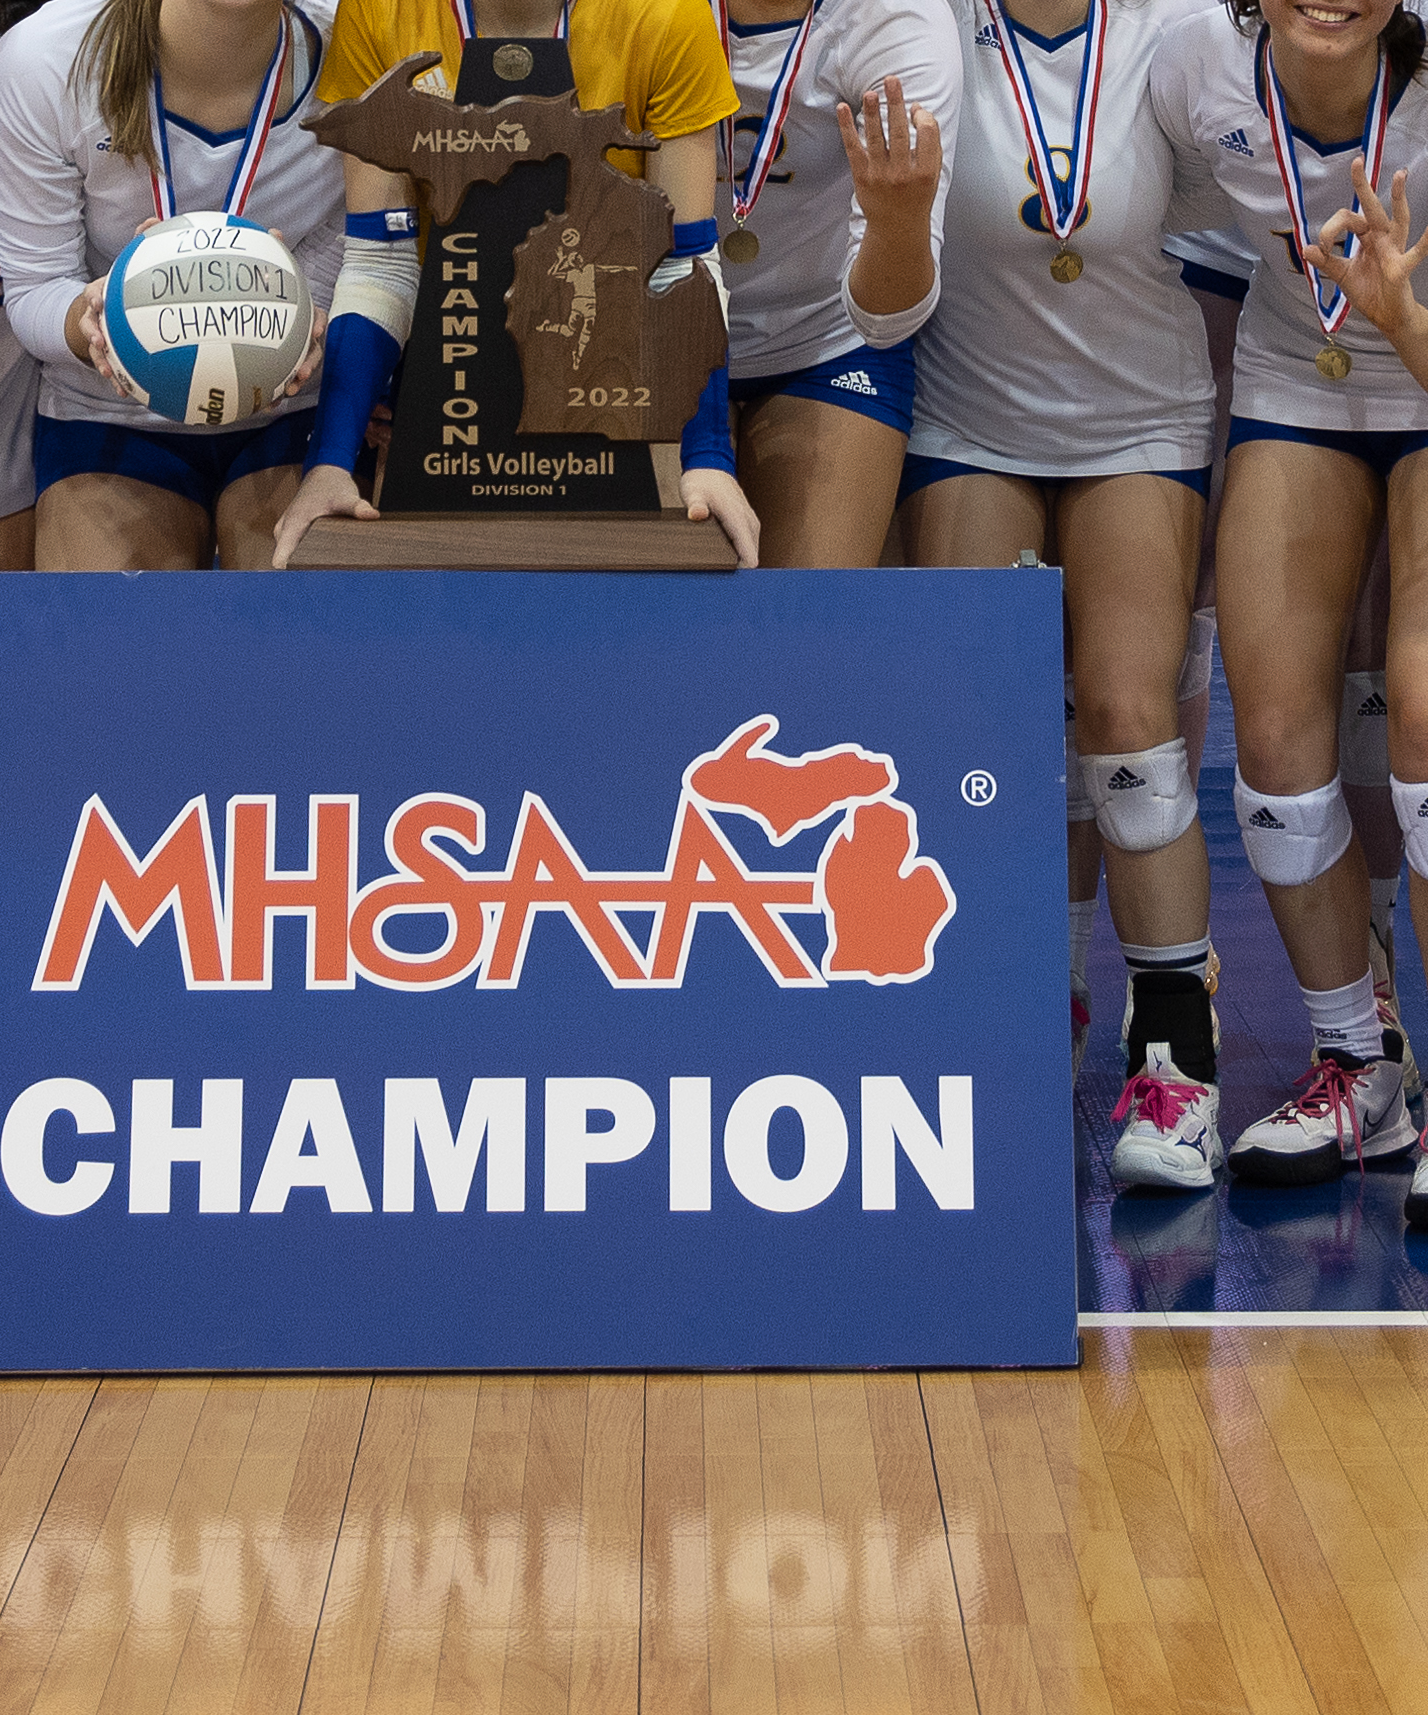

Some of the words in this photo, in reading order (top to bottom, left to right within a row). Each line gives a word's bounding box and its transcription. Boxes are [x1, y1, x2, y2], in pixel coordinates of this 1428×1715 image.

[411, 129, 515, 154] MHSAA
[1217, 137, 1255, 158] adidas
[1019, 144, 1092, 234] 8
[177, 228, 247, 254] 2022
[151, 260, 270, 300] DIVISION
[275, 268, 288, 300] 1
[158, 304, 289, 344] CHAMPION
[440, 232, 479, 446] CHAMPION
[567, 387, 652, 408] 2022
[830, 377, 878, 396] adidas
[423, 452, 481, 476] Girls
[486, 452, 615, 481] Volleyball
[471, 484, 554, 496] DIVISION
[559, 484, 567, 496] 1
[1108, 777, 1148, 791] adidas
[31, 788, 833, 995] MHSAA
[0, 1076, 976, 1217] CHAMPION
